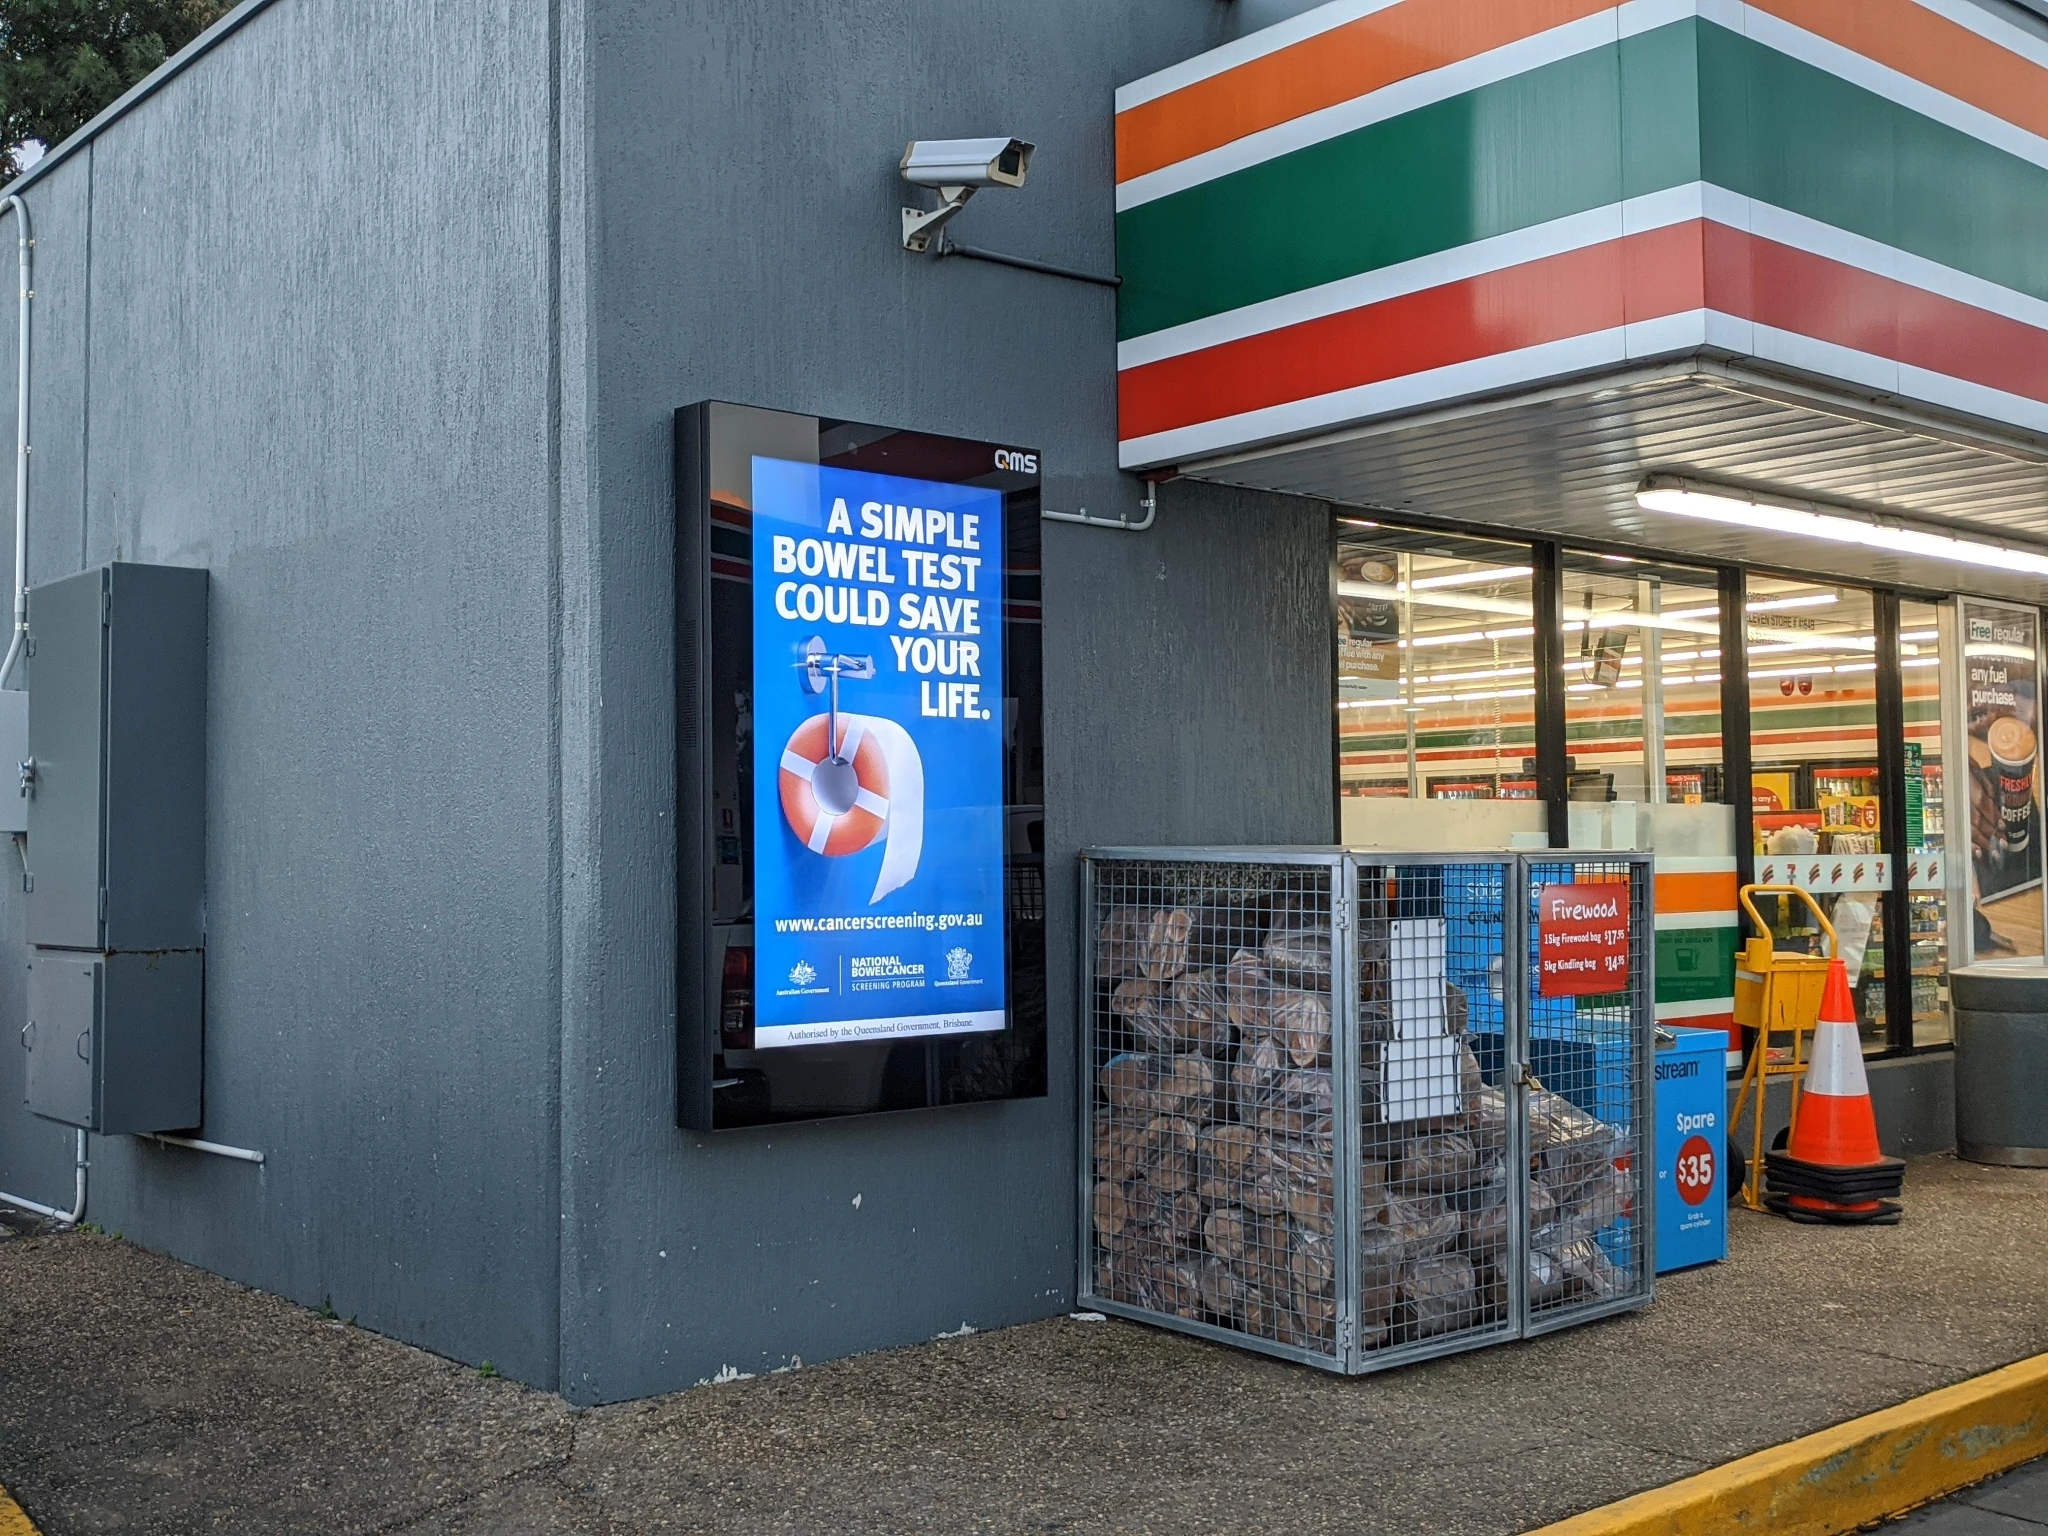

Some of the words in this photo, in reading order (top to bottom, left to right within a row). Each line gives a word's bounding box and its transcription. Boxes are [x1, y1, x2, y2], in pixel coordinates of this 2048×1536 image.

[827, 498, 852, 535] A
[860, 501, 980, 550] SIMPLE
[773, 535, 895, 584] BOWEL
[902, 550, 981, 591] TEST
[775, 582, 890, 626] COULD
[898, 593, 980, 634] SAVE
[1771, 615, 1791, 628] STORE
[1971, 621, 1991, 638] Free
[1993, 627, 2025, 645] regular
[1349, 638, 1372, 649] regular
[890, 635, 980, 676] YOUR
[1356, 649, 1371, 659] with
[1372, 653, 1384, 662] any
[1346, 661, 1379, 671] purchase.
[1971, 667, 1988, 686] any
[1989, 666, 2007, 684] fuel
[921, 680, 990, 720] LIFE.
[1972, 688, 2016, 707] purchase.
[2001, 803, 2031, 822] COFFEE
[1552, 897, 1618, 921] Firewood
[775, 911, 983, 932] www.cancerscreening.gov.au
[1544, 933, 1560, 947] 15kg
[1561, 931, 1589, 944] Firewood
[1590, 931, 1601, 944] bag
[1604, 929, 1625, 946] $17.95
[851, 955, 901, 967] NATIONAL
[851, 964, 924, 978] BOWELCANCER
[1544, 960, 1557, 973] 5kg
[1557, 958, 1584, 972] Kindling
[1584, 957, 1596, 971] bag
[1604, 955, 1625, 972] $14.95
[851, 981, 890, 991] SCREENING
[892, 979, 925, 990] PROGRAM
[787, 1028, 828, 1040] Authorised
[829, 1027, 839, 1039] by
[841, 1026, 852, 1036] the
[853, 1023, 895, 1036] Queensland
[896, 1020, 941, 1032] Government,
[943, 1018, 974, 1028] Brisbane.
[1676, 1112, 1715, 1134] Spare
[1678, 1154, 1712, 1187] $35
